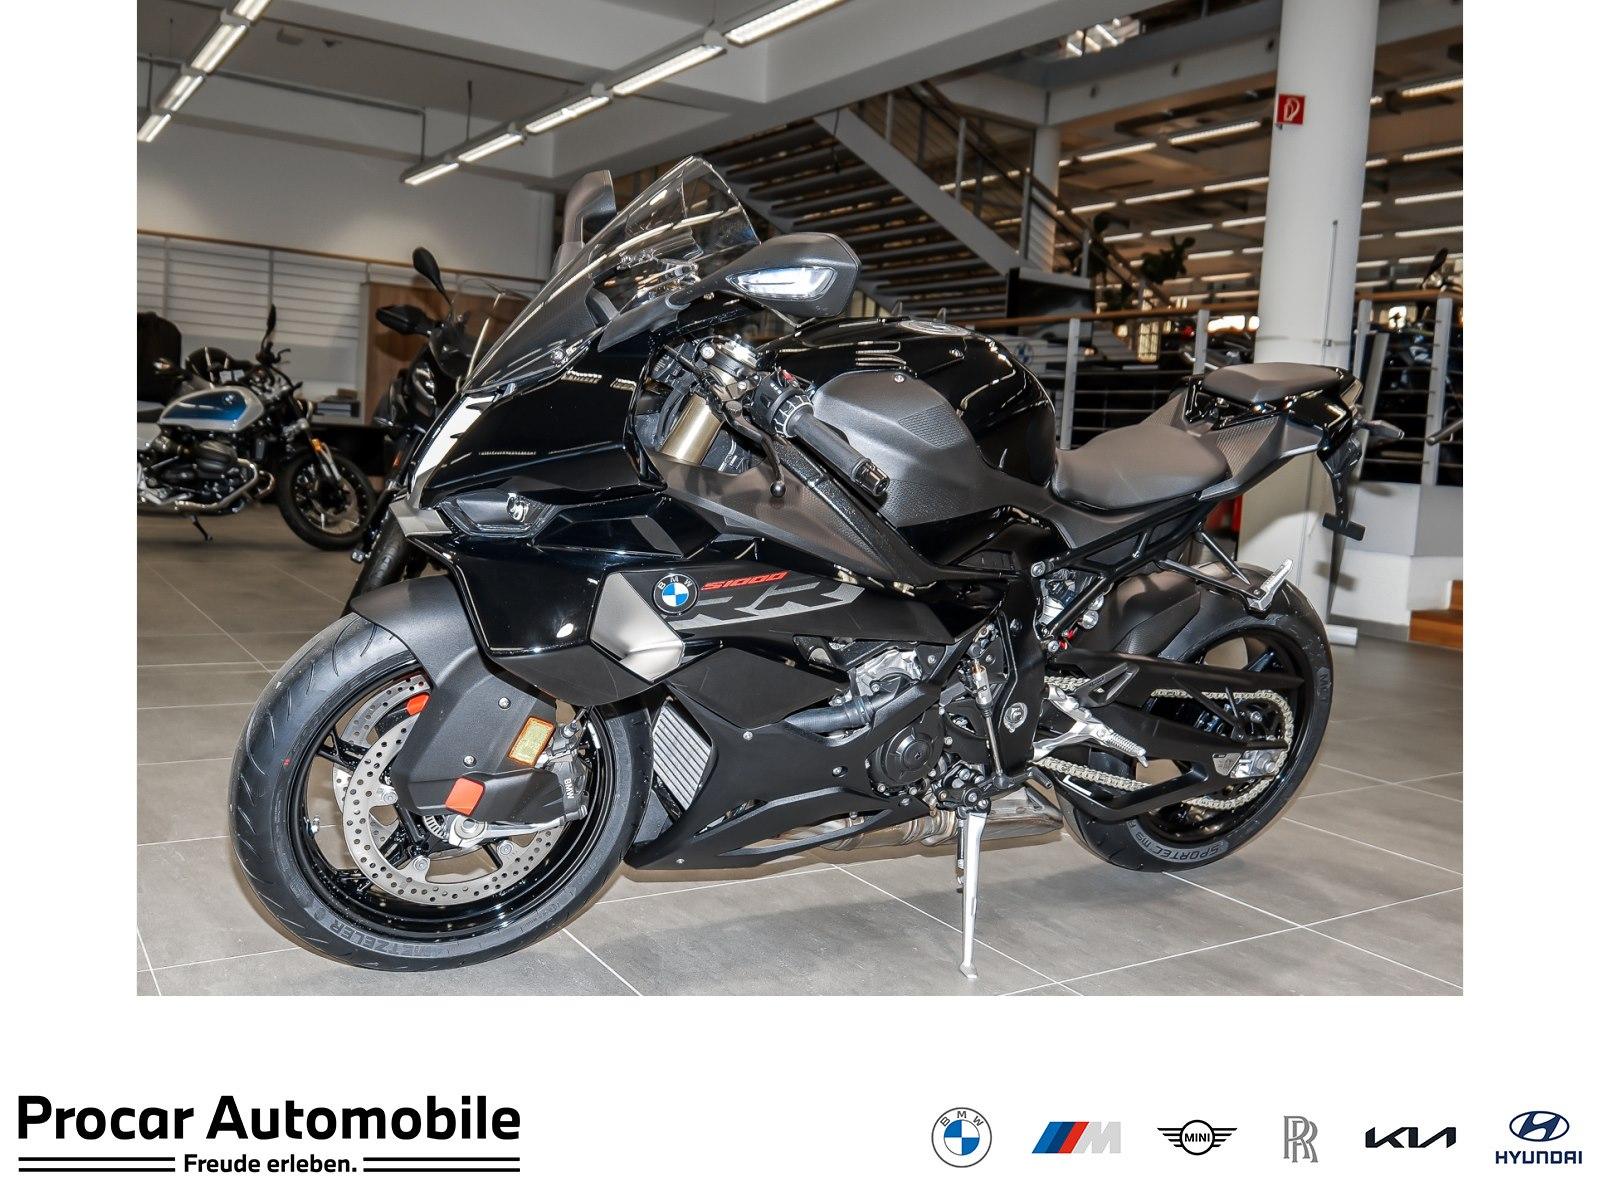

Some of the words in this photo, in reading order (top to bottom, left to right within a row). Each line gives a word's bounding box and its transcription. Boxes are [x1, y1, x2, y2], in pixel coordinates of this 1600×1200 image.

[657, 576, 693, 590] BMW
[701, 570, 789, 591] S1000
[564, 778, 575, 799] BMW
[1153, 845, 1219, 860] SPORTEC
[330, 919, 430, 958] METZELER
